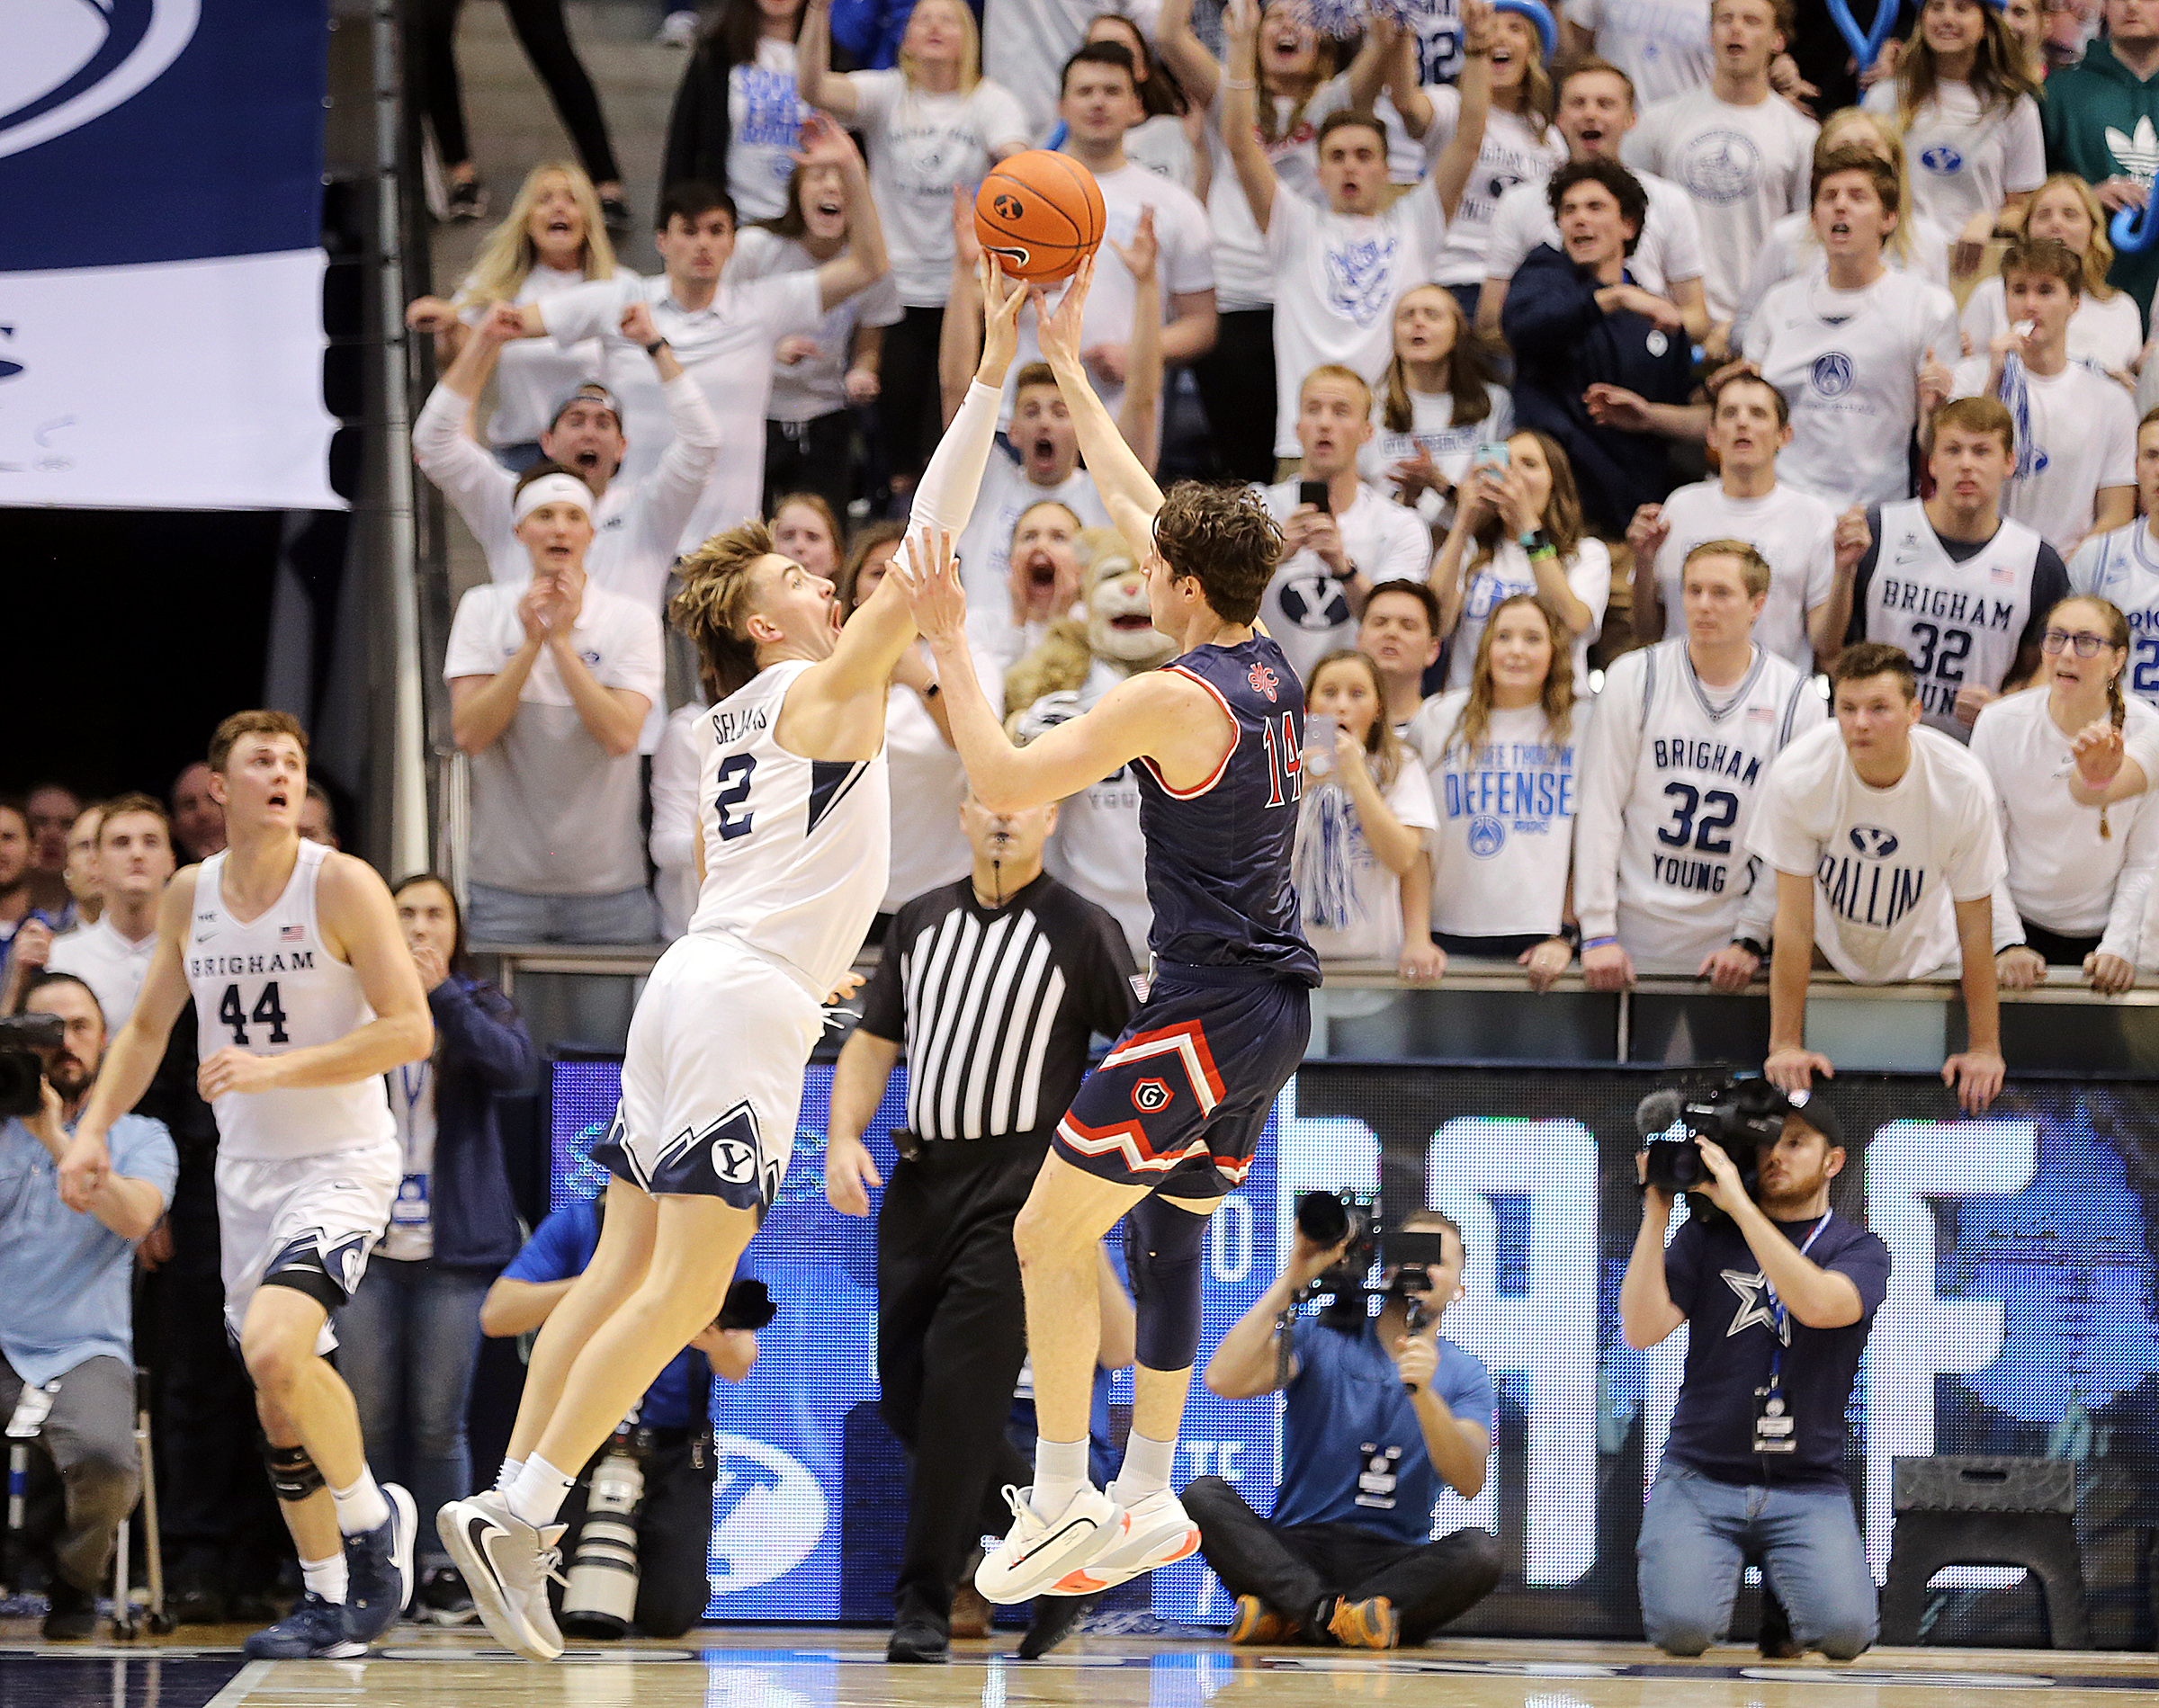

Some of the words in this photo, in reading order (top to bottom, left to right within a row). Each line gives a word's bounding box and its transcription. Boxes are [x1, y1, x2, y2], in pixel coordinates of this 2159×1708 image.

[1286, 577, 1347, 630] Y
[1883, 580, 2013, 630] BRIGHAM
[1912, 622, 1972, 682] 32
[1262, 711, 1303, 809] 14
[1654, 738, 1761, 786] BRIGHAM
[714, 753, 757, 841] 2
[1447, 772, 1573, 818] DEFENSE
[1658, 782, 1738, 854] 32
[1653, 854, 1727, 893] YOUNG
[1817, 854, 1923, 927] BALLIN
[192, 952, 314, 978] BRIGHAM
[221, 981, 289, 1044] 44
